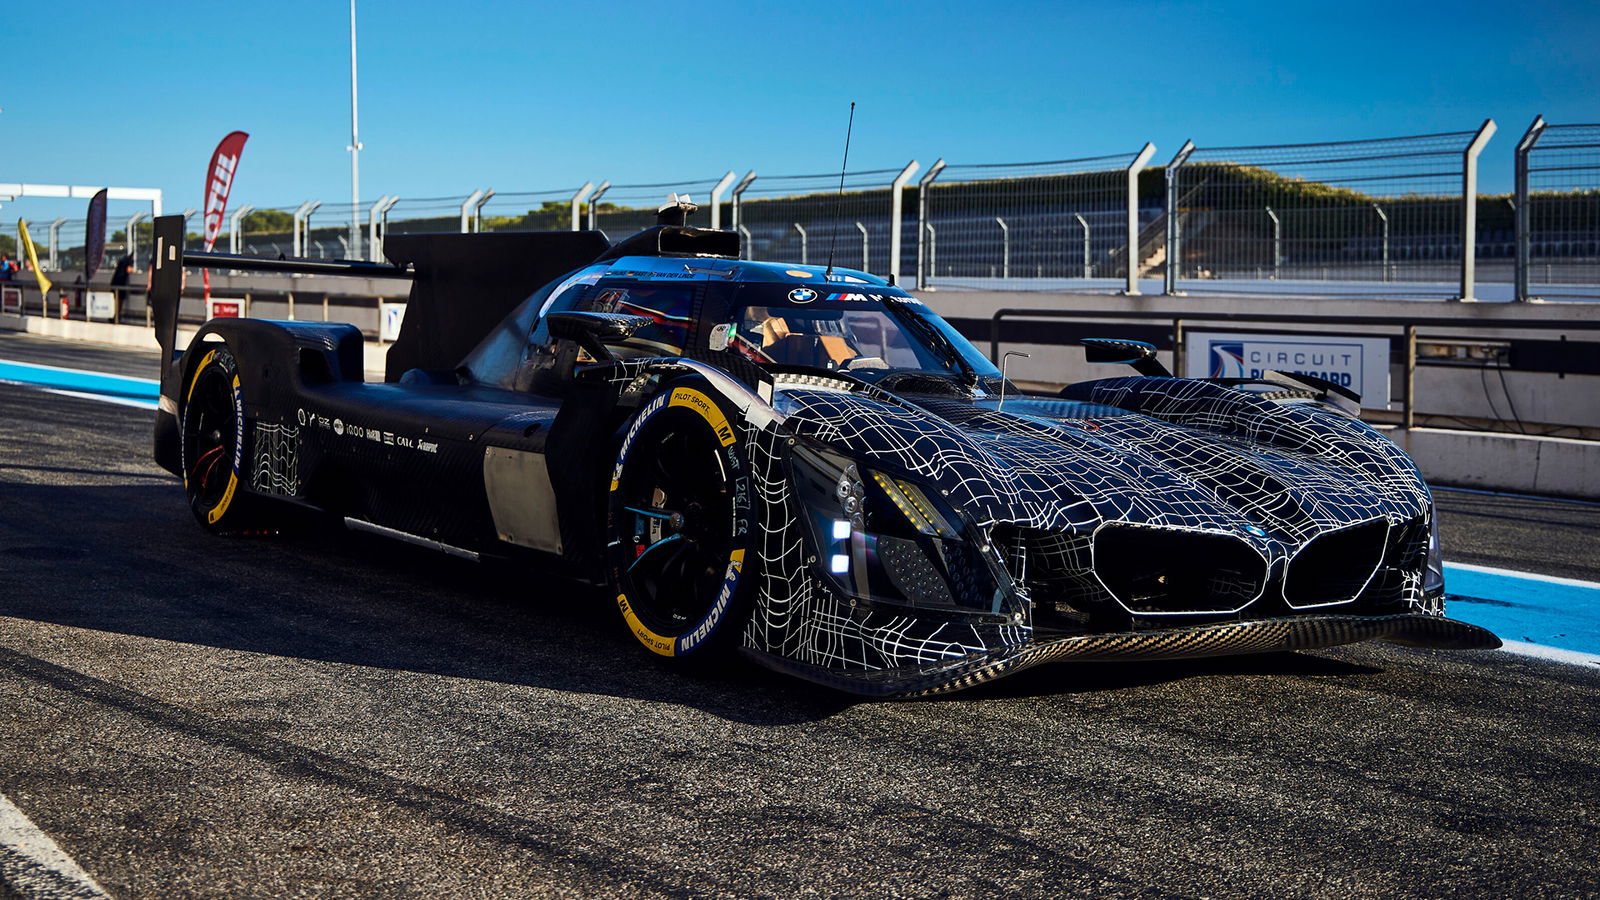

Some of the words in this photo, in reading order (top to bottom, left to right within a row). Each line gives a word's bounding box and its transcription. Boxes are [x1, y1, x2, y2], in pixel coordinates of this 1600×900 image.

[1250, 351, 1352, 366] CIRCUIT
[1294, 370, 1352, 387] ARD
[674, 393, 690, 403] PILOT
[691, 396, 711, 412] SPORT
[234, 400, 243, 469] MICHELIN
[620, 394, 666, 460] MICHELIN
[718, 426, 731, 441] M
[619, 600, 628, 613] M
[681, 583, 731, 652] MICHELIN
[637, 629, 654, 644] SPORT
[655, 643, 671, 651] PILOT
